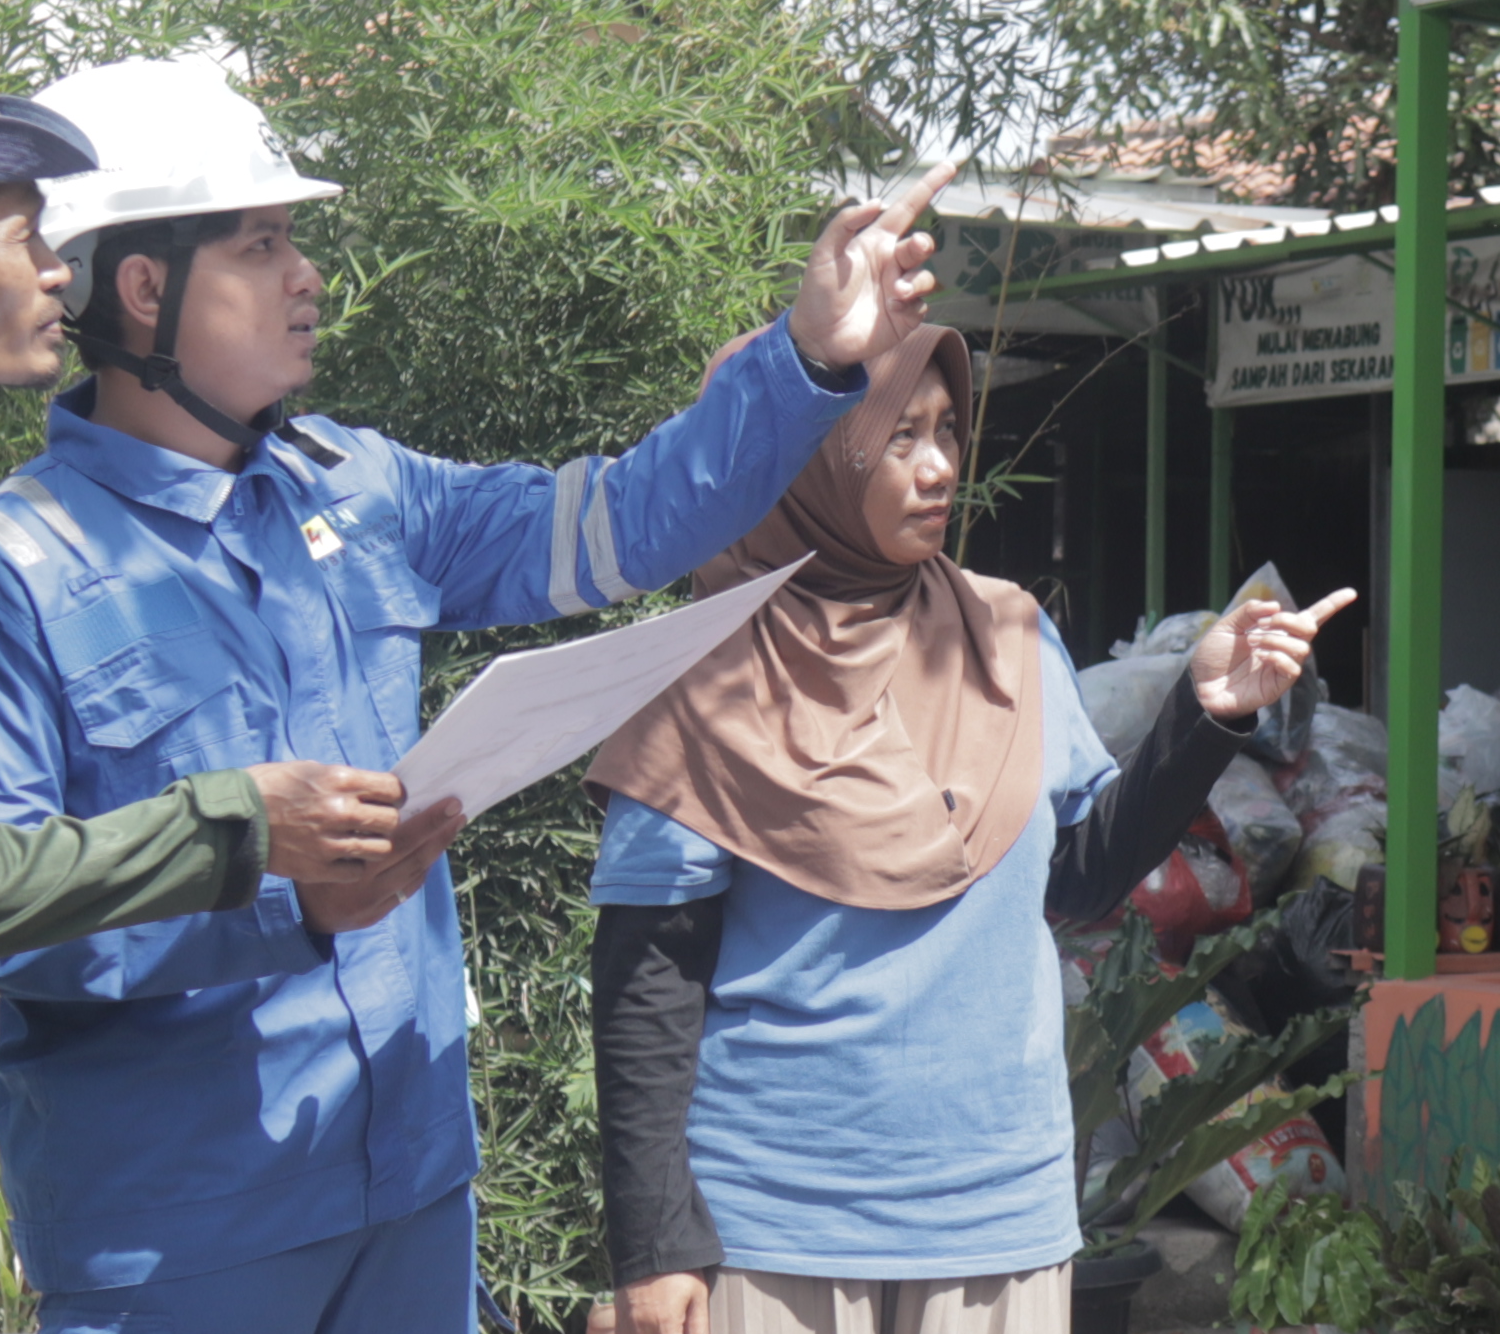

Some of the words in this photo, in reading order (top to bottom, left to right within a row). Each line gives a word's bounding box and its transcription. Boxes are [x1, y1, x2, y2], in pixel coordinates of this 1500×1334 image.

[1257, 330, 1298, 357] MULAI
[1301, 322, 1381, 353] MENABUNG
[1231, 365, 1288, 390] SAMPAH
[1291, 359, 1326, 385] DARI
